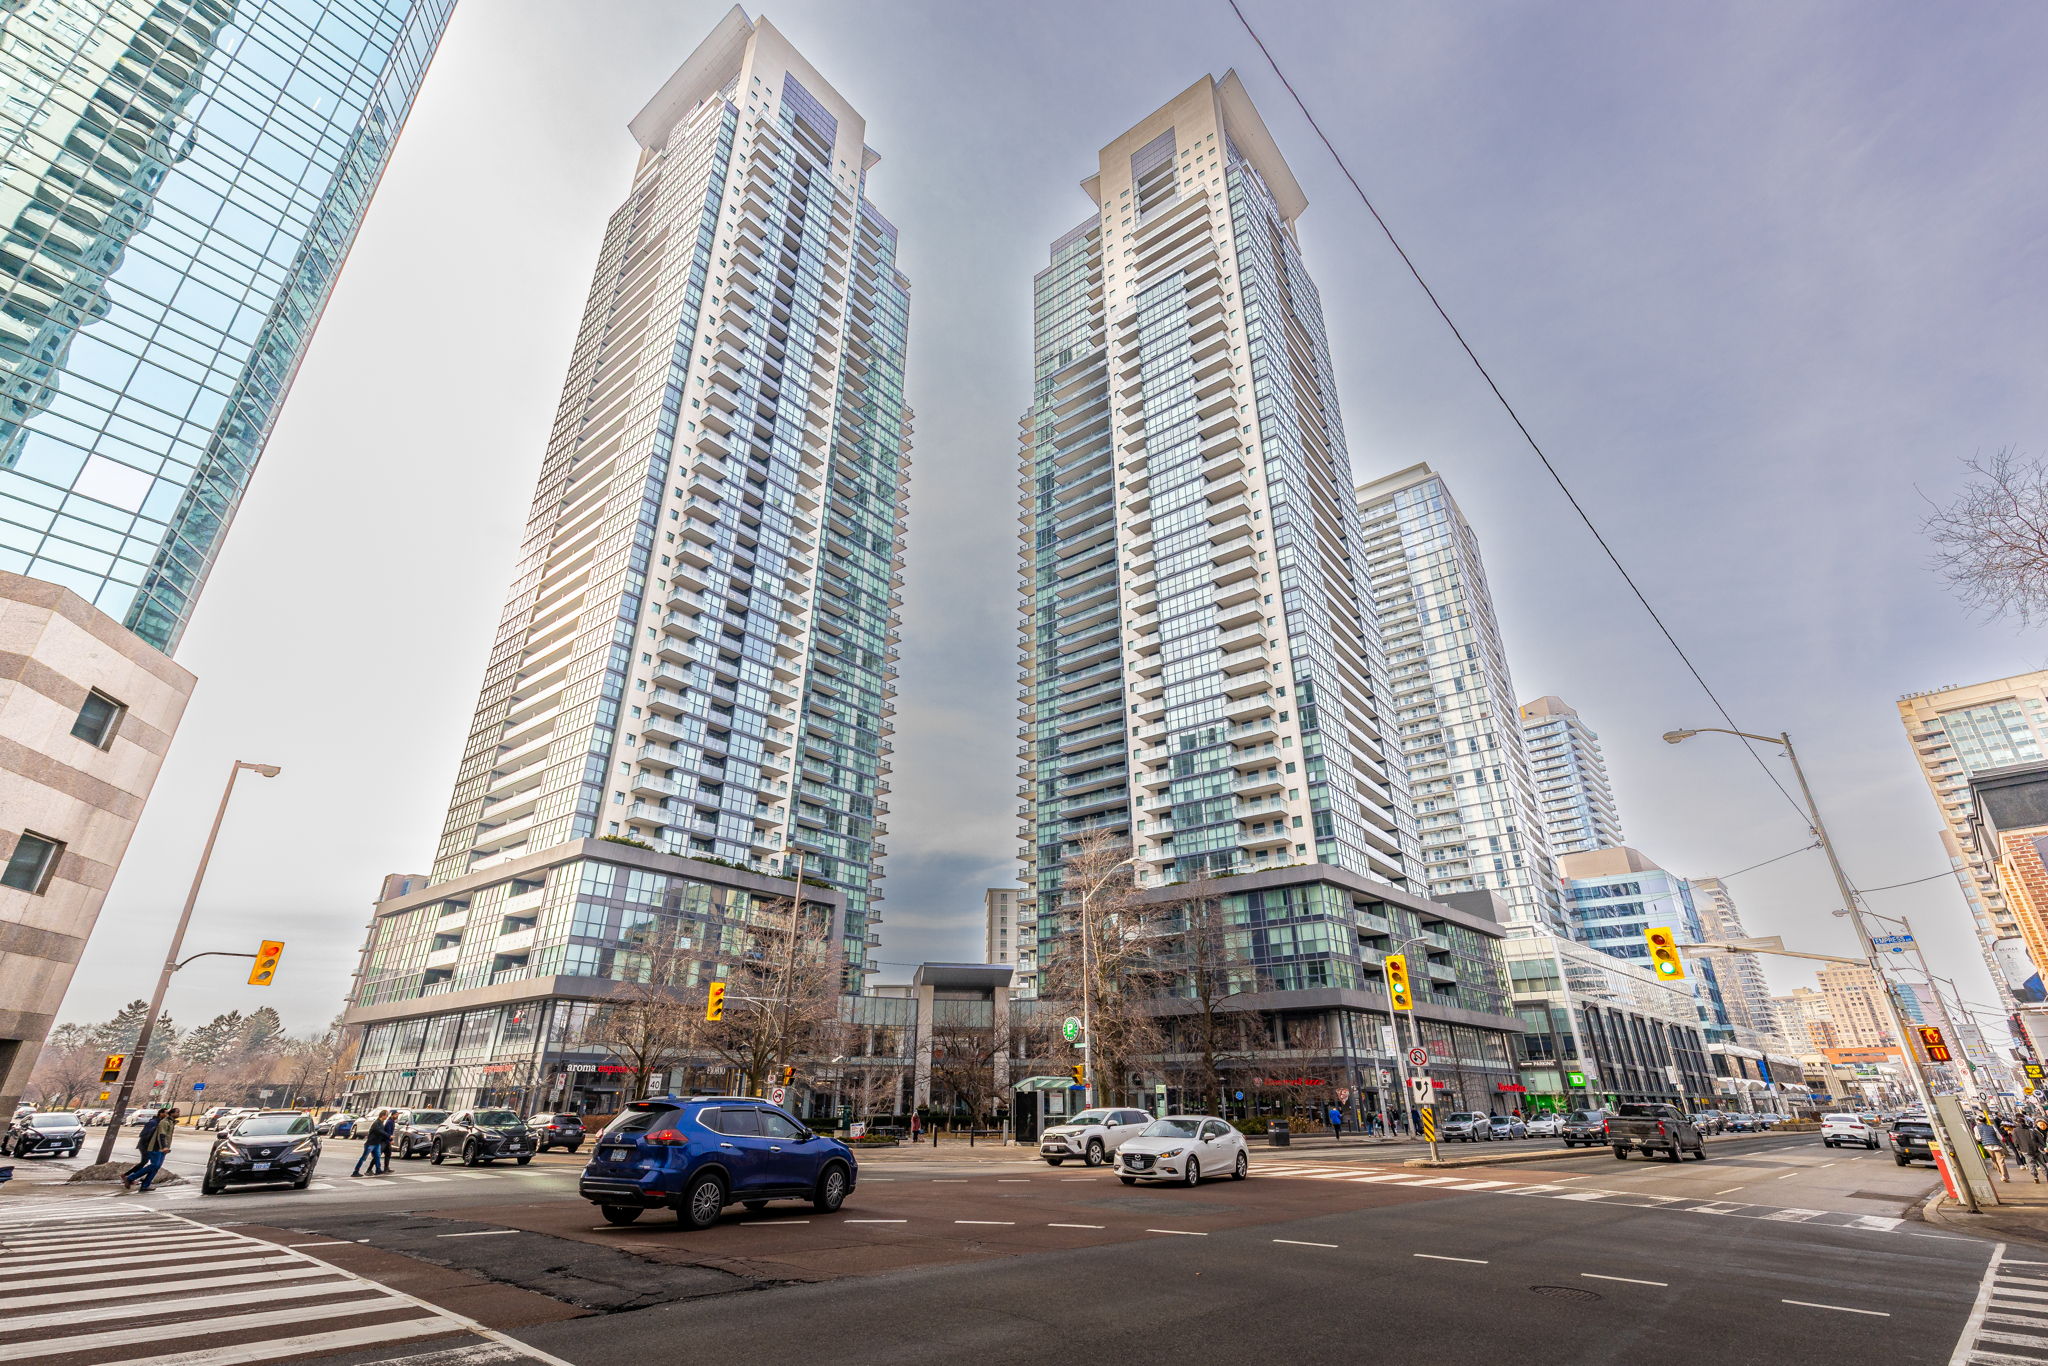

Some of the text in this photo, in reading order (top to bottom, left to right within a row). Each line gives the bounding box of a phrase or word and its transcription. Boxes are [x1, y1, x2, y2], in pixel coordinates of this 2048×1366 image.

[1874, 936, 1905, 944] EMPRESS
[567, 1063, 597, 1072] aroma
[1570, 1075, 1584, 1084] TD
[650, 1081, 660, 1089] 40
